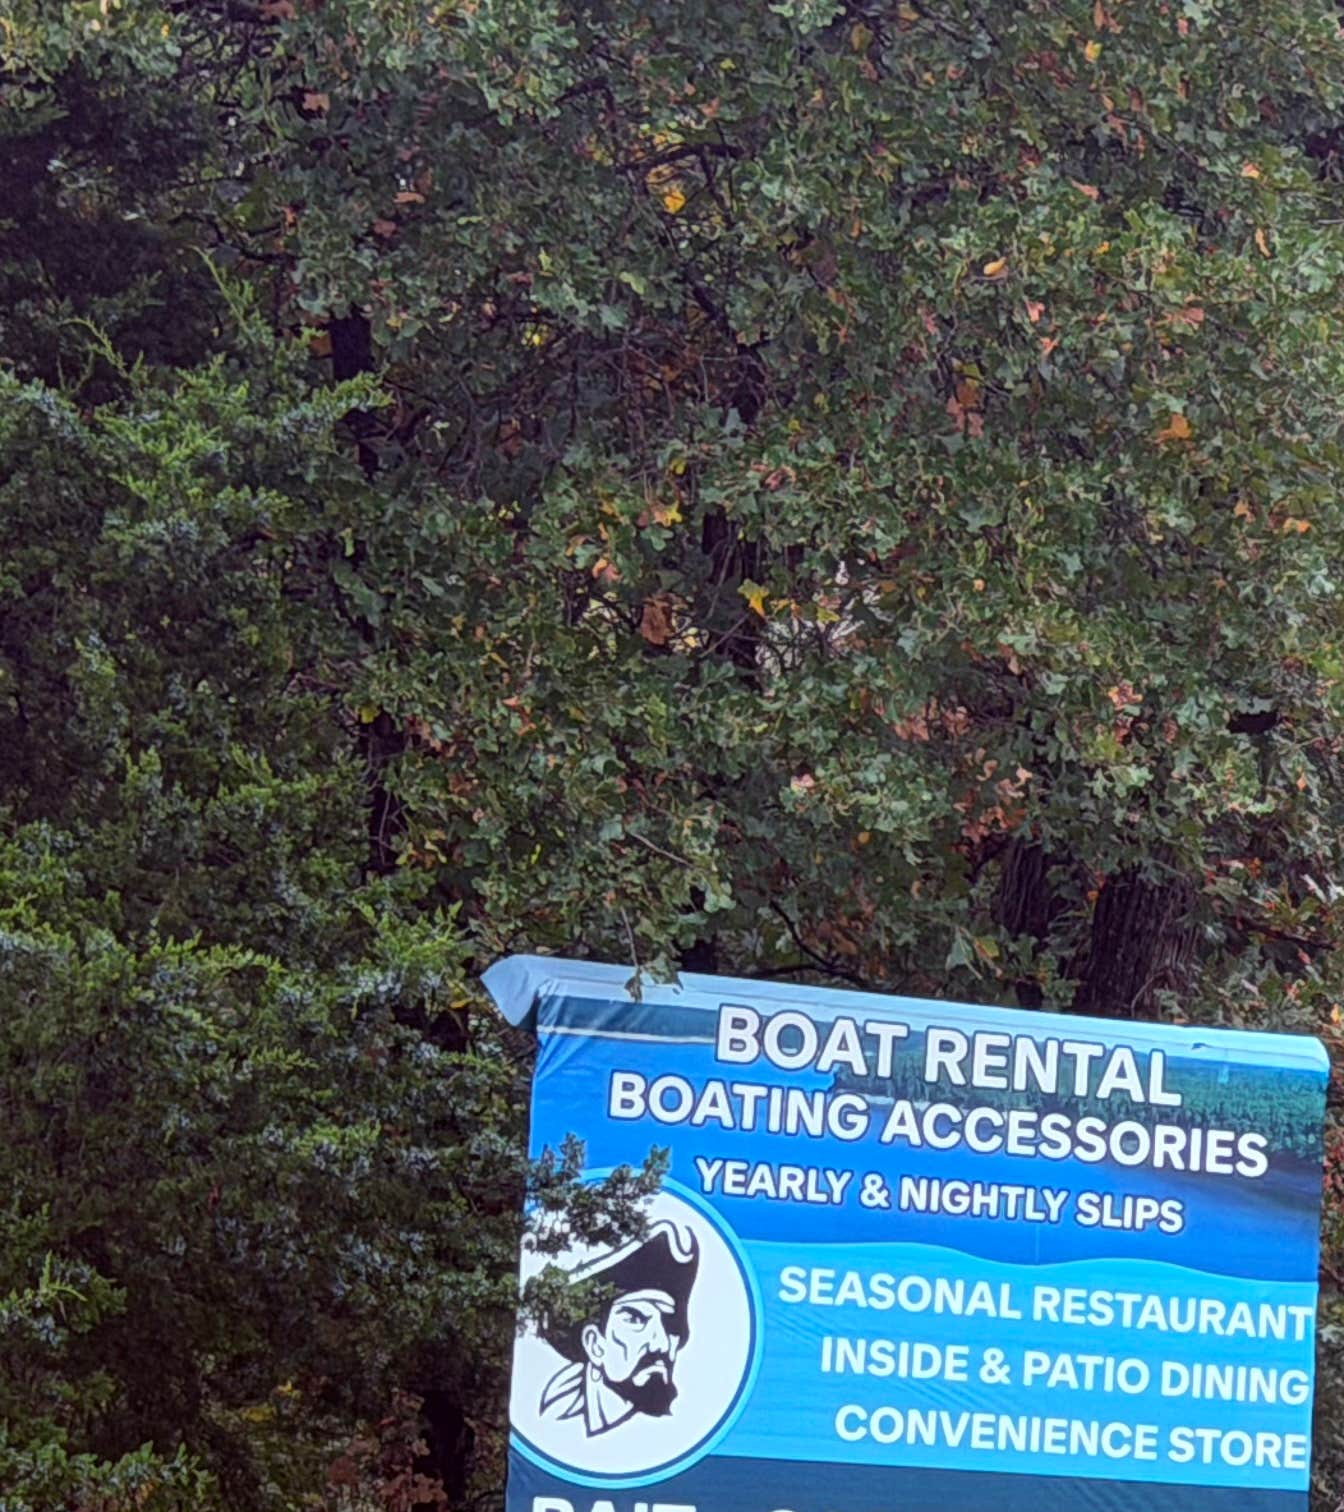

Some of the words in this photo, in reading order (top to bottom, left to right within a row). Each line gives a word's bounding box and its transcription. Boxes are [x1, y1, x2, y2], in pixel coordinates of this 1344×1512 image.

[715, 1005, 909, 1079] BOAT
[921, 1026, 1183, 1107] RENTAL
[607, 1069, 869, 1143] BOATING
[880, 1099, 1269, 1179] ACCESSORIES
[696, 1157, 853, 1207] YEARLY
[859, 1174, 890, 1209] &
[897, 1176, 1069, 1226] NIGHTLY
[1076, 1190, 1184, 1233] SLIPS
[778, 1266, 1021, 1320] SEASONAL
[1033, 1286, 1312, 1341] RESTAURANT
[820, 1337, 969, 1382] INSIDE
[979, 1347, 1011, 1384] &
[1023, 1352, 1149, 1395] PATIO
[1161, 1362, 1309, 1405] DINING
[835, 1404, 1158, 1460] CONVENIENCE
[1168, 1428, 1307, 1469] STORE
